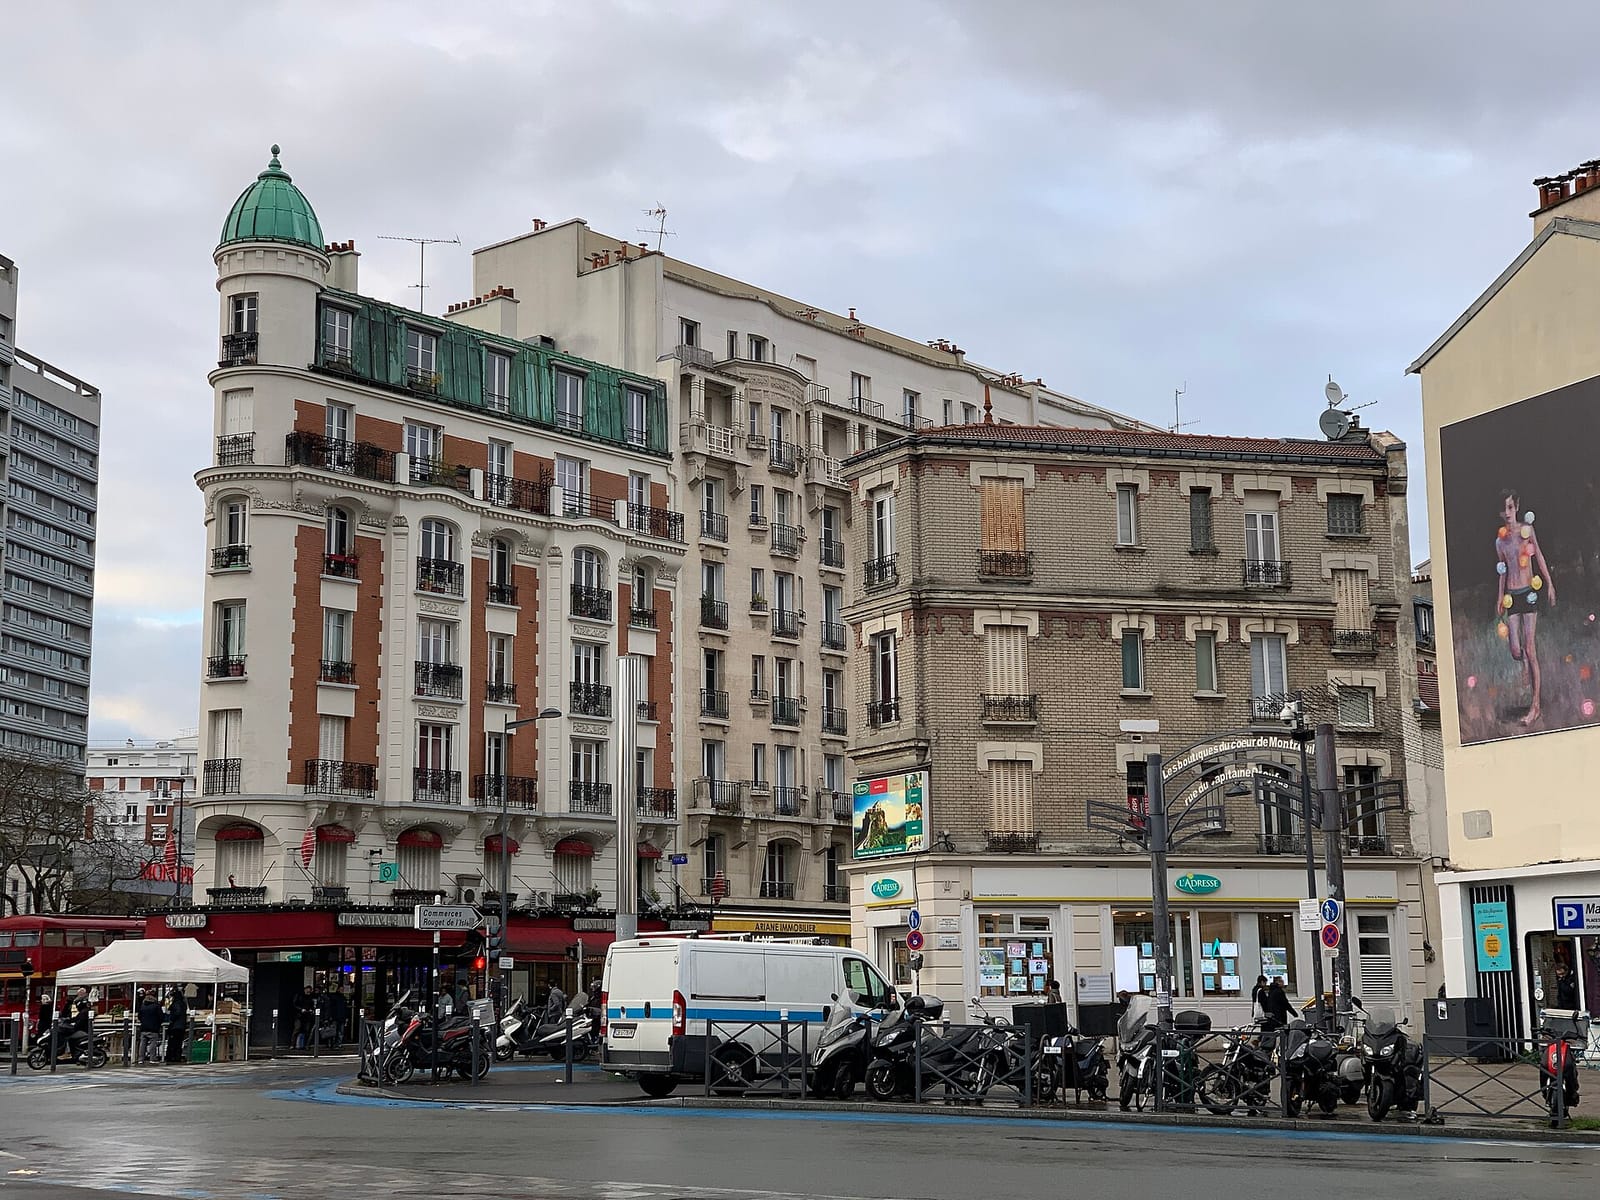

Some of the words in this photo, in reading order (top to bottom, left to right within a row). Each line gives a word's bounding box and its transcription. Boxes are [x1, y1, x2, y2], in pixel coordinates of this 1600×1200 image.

[1162, 763, 1178, 780] Les
[1178, 746, 1219, 770] boutiques
[1219, 740, 1230, 752] du
[1231, 738, 1256, 750] coeur
[1257, 736, 1268, 748] de
[1184, 789, 1198, 807] rue
[1198, 781, 1209, 794] du
[1211, 768, 1251, 786] apitaine
[423, 909, 463, 918] Commerces
[1563, 906, 1578, 927] P
[168, 915, 204, 927] TABAC
[423, 918, 445, 928] Rouget
[446, 918, 454, 927] de
[755, 922, 779, 932] ARIANE
[780, 923, 816, 933] IMMOBILIER
